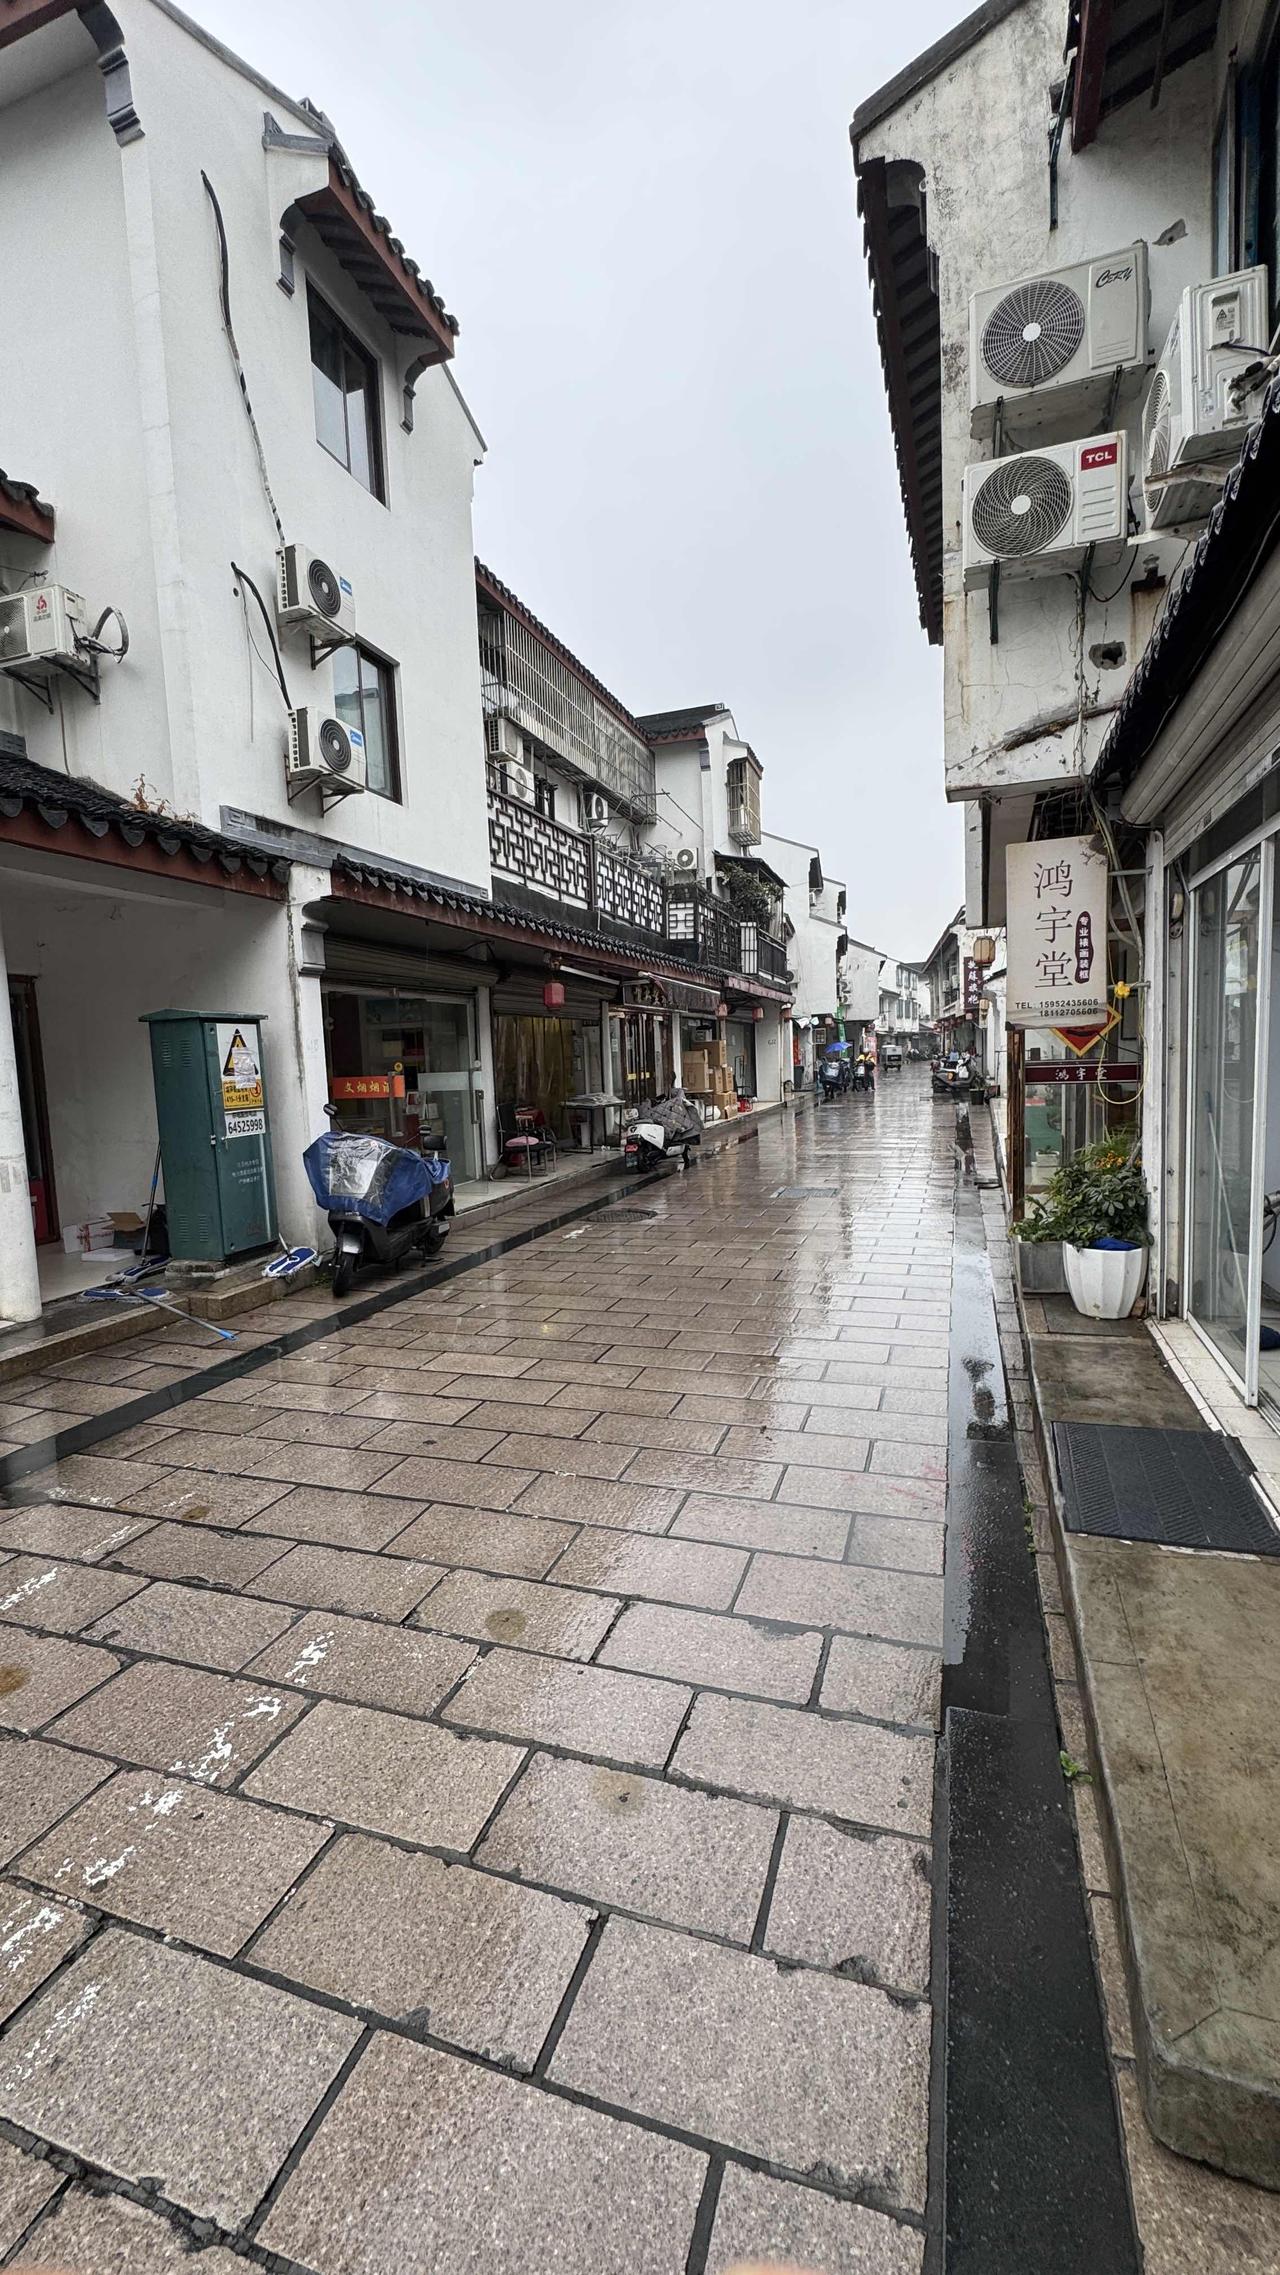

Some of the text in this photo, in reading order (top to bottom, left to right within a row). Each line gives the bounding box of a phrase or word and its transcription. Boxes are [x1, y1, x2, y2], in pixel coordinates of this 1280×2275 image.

[1086, 451, 1112, 463] TCL
[1033, 859, 1073, 988] 鸿宇堂
[1040, 999, 1099, 1009] 15952435606
[1040, 1008, 1098, 1018] 18112705606
[1055, 1066, 1107, 1080] 鸿宇堂
[228, 1119, 263, 1134] 64525998
